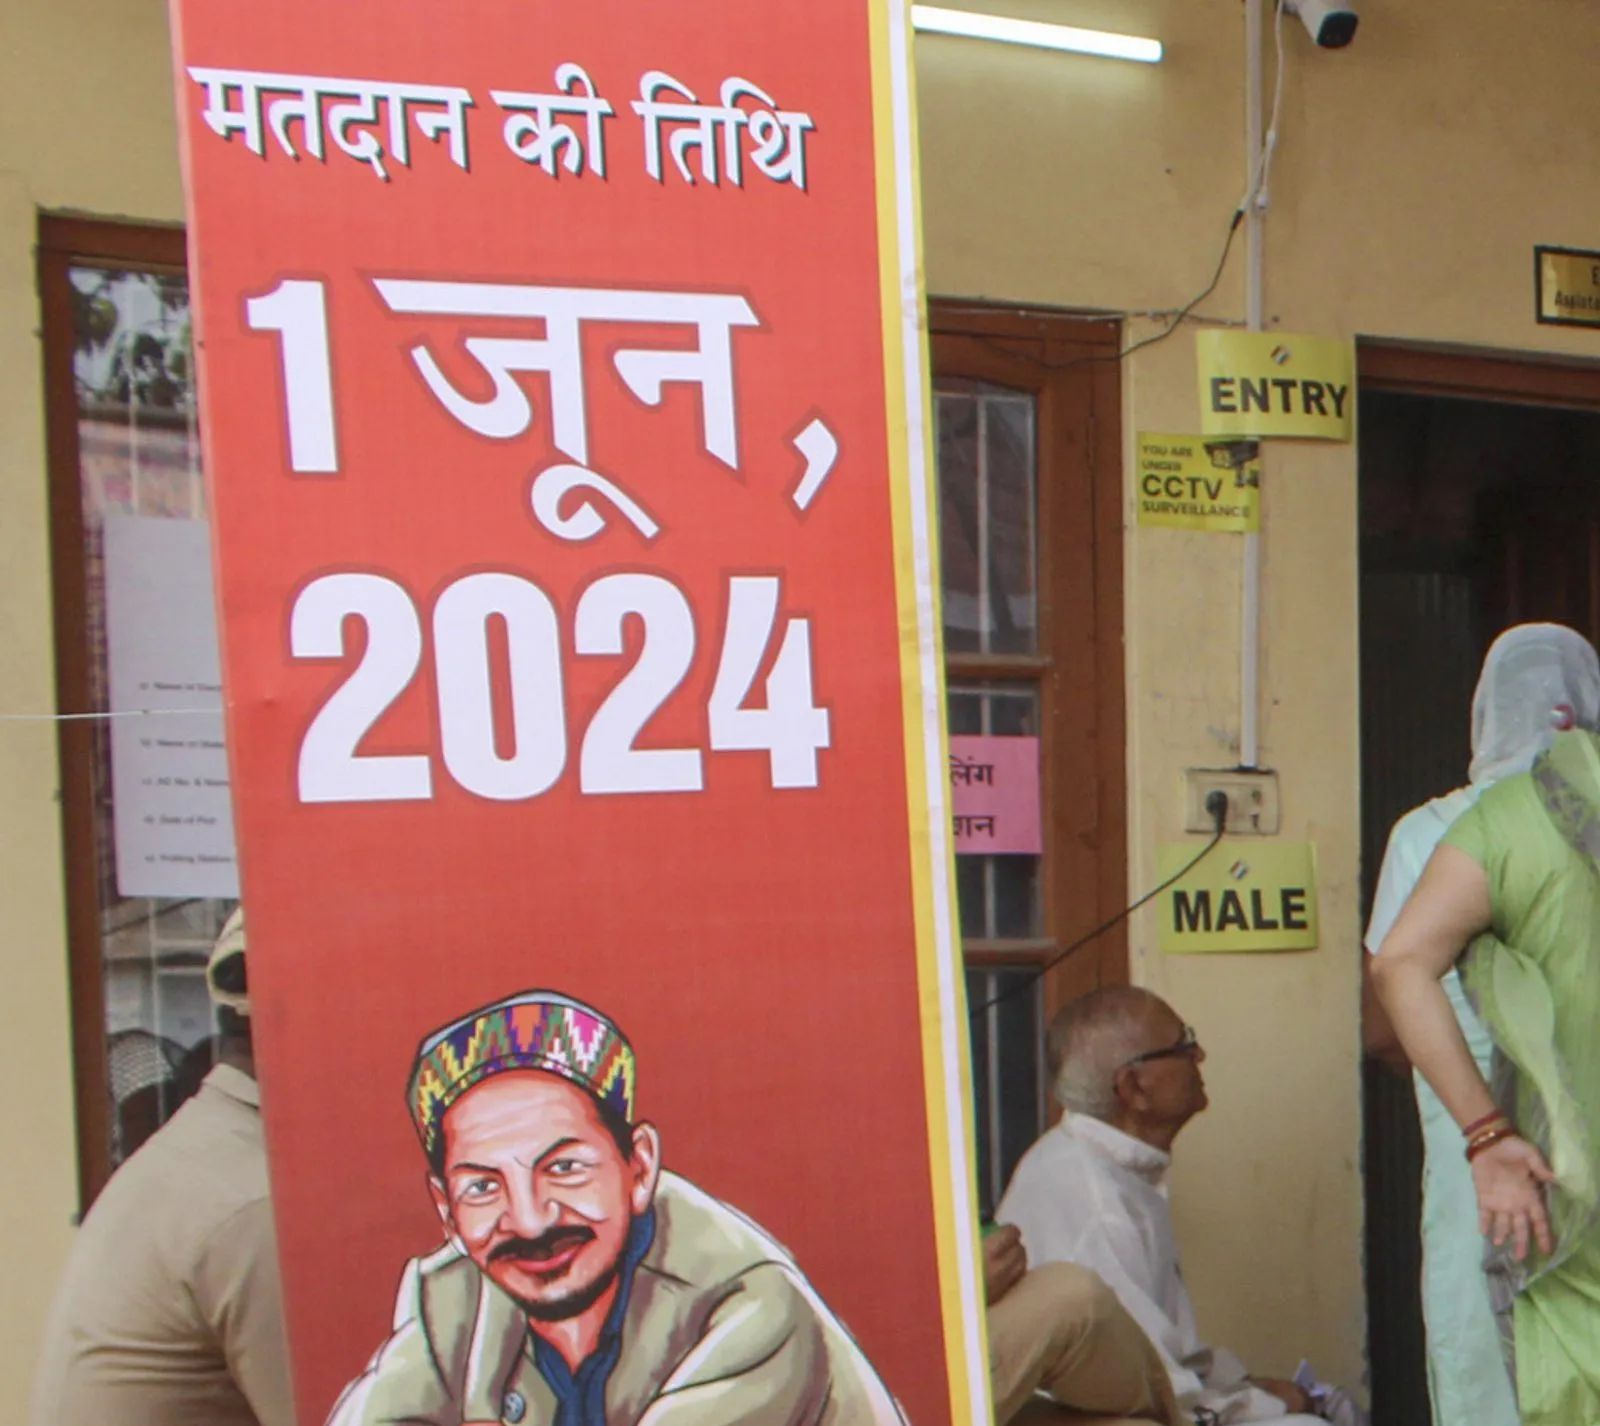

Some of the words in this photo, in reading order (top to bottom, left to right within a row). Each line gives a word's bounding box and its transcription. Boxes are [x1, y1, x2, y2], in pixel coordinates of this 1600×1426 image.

[187, 65, 473, 180] मतदान
[490, 62, 613, 177] की
[630, 71, 814, 190] तिथि
[246, 279, 338, 473] 1
[1210, 377, 1348, 418] ENTRY
[1142, 459, 1182, 472] UNDER
[1143, 445, 1167, 457] YOU
[1170, 446, 1193, 458] ARE
[1141, 473, 1223, 501] CCTV
[1142, 500, 1250, 518] SURVEILLANCE
[290, 572, 830, 803] 2024
[1172, 887, 1309, 934] MALE
